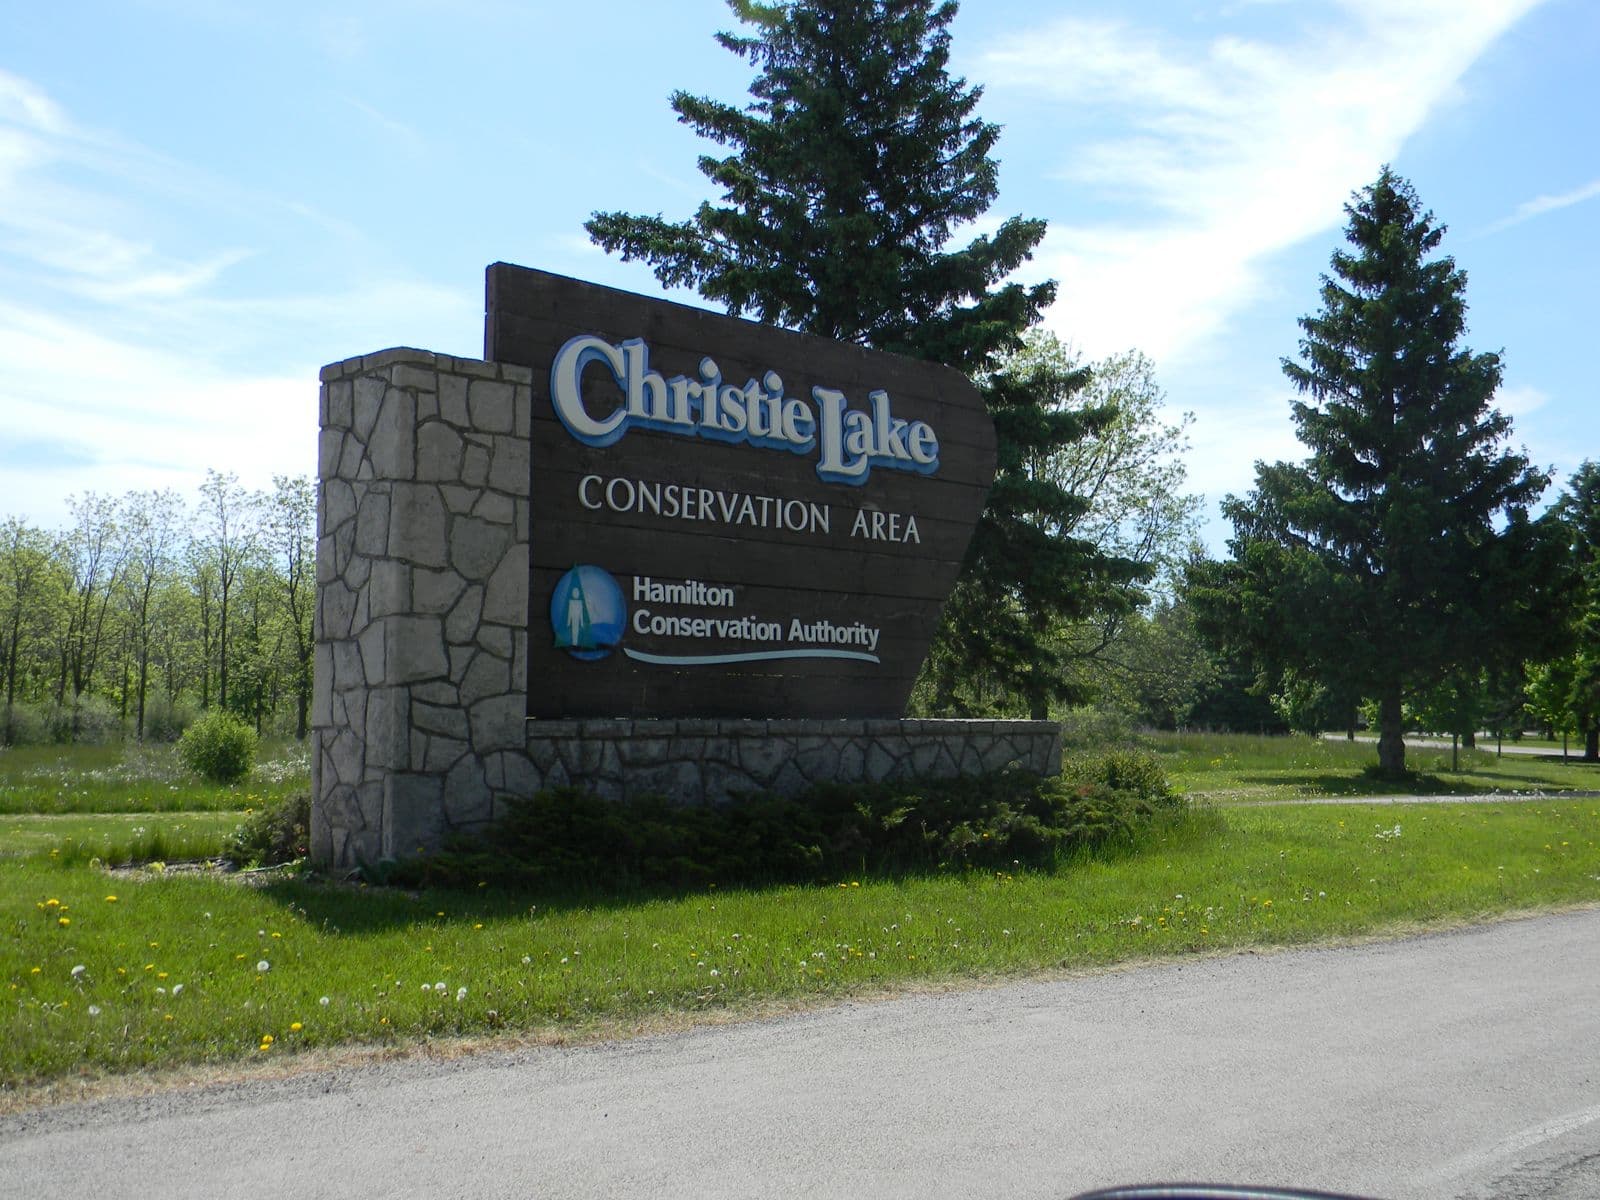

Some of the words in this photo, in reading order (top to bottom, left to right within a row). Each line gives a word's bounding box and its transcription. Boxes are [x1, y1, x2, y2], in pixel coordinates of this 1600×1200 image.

[551, 336, 816, 452] Christie
[812, 385, 940, 484] Lake
[578, 474, 830, 534] CONSERVATION
[850, 508, 921, 544] AREA
[633, 575, 734, 607] Hamilton
[633, 609, 782, 641] Conservation
[787, 617, 880, 653] Authority
